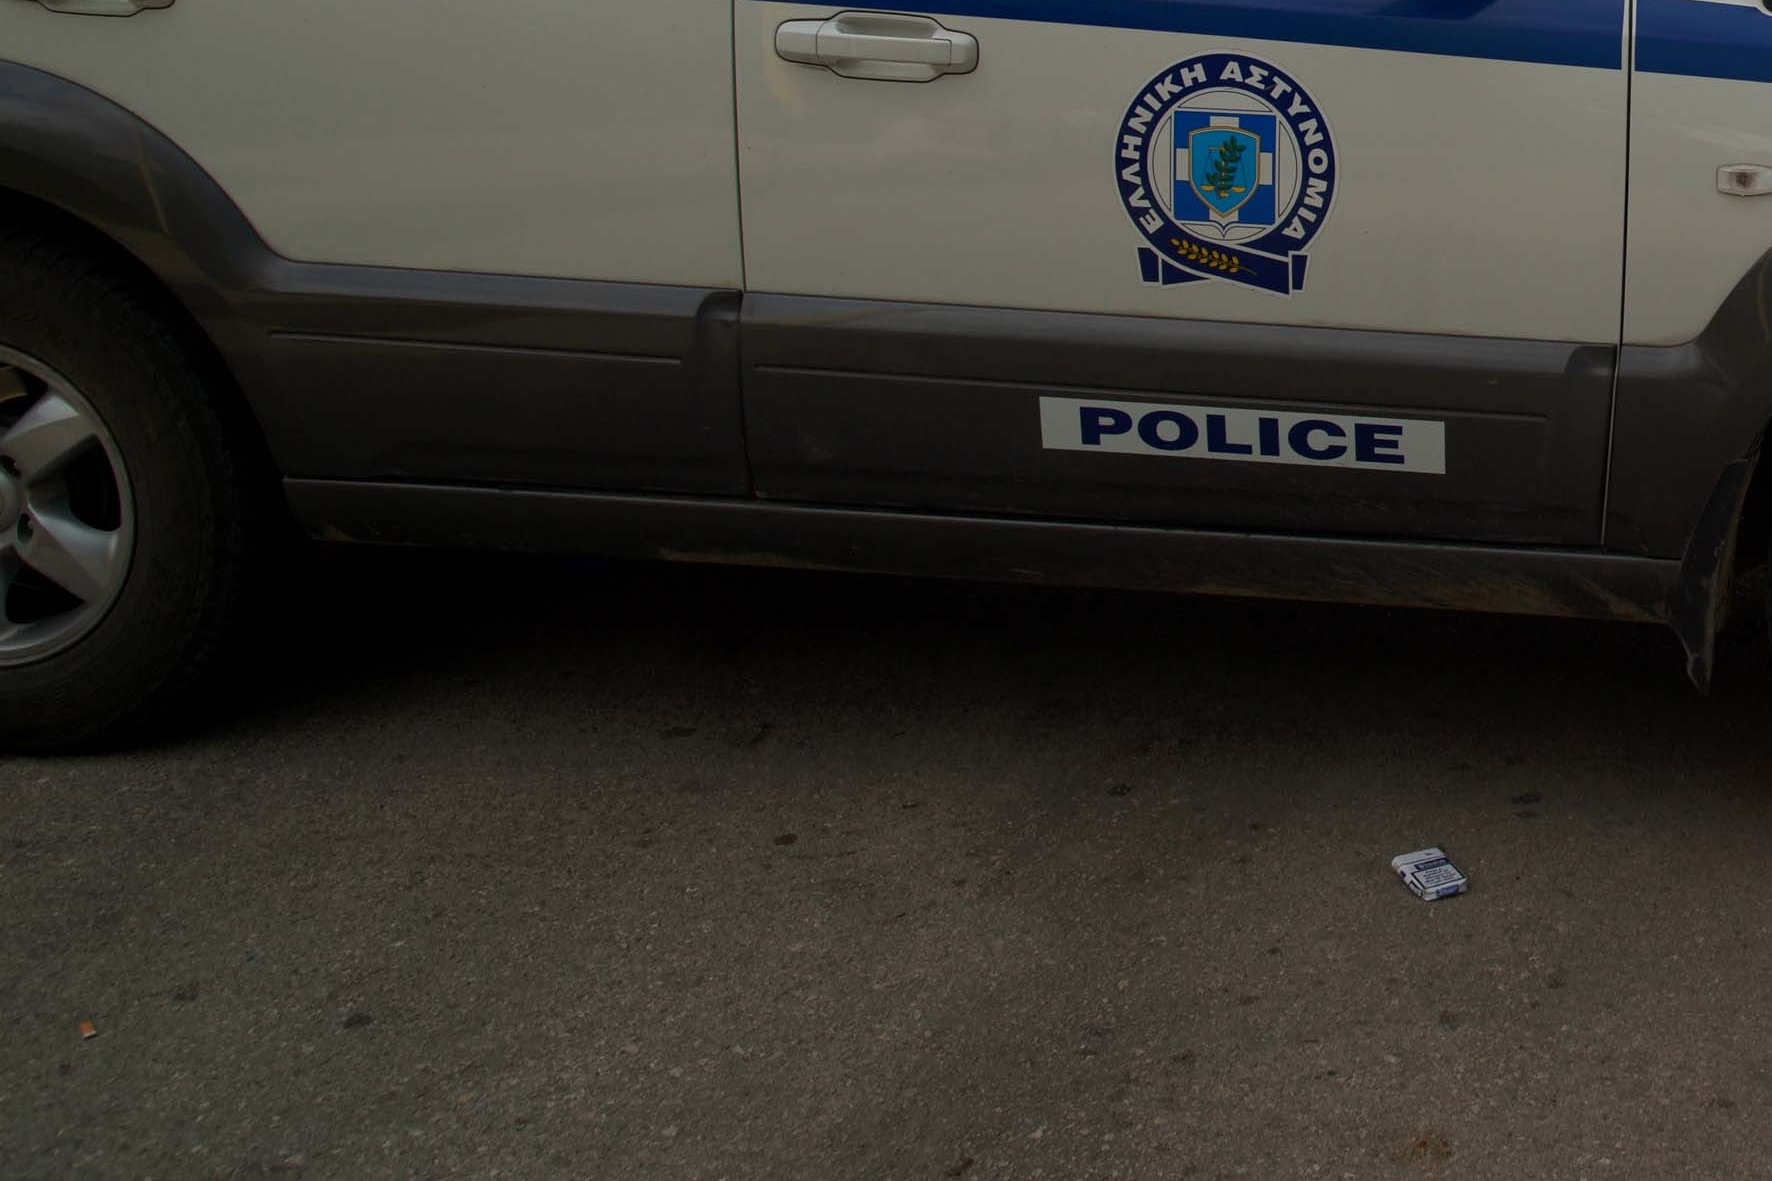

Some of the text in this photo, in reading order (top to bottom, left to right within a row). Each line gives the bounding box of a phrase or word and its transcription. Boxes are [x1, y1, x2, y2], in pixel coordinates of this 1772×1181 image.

[1121, 61, 1328, 240] ΕΛΛΗΝΙΚΗ ΑΣΤΥΝΟΜΙΑ
[1079, 406, 1405, 464] POLICE
